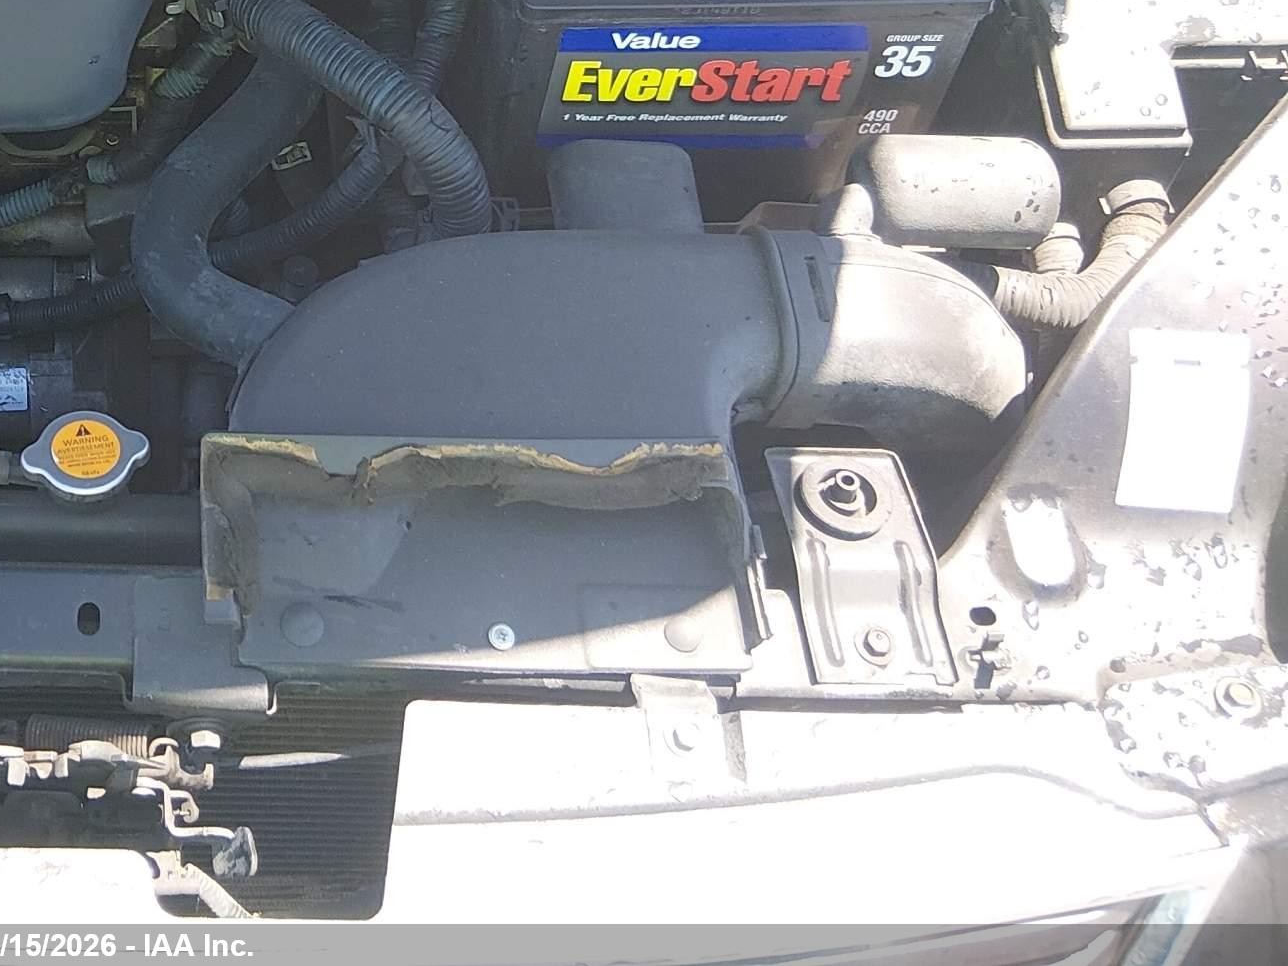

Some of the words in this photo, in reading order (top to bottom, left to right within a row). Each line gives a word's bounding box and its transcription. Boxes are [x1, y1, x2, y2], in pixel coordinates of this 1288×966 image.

[612, 32, 702, 50] Value
[886, 34, 921, 42] GROUP
[921, 34, 945, 42] SIZE
[874, 45, 937, 78] 35
[561, 58, 853, 103] EverStart
[562, 113, 570, 121] 1
[574, 113, 604, 122] Year
[605, 113, 636, 122] Free
[638, 113, 725, 123] Replacement
[728, 114, 789, 123] Warranty
[863, 109, 899, 122] 490
[858, 122, 891, 135] CCA
[63, 435, 109, 447] WARNING
